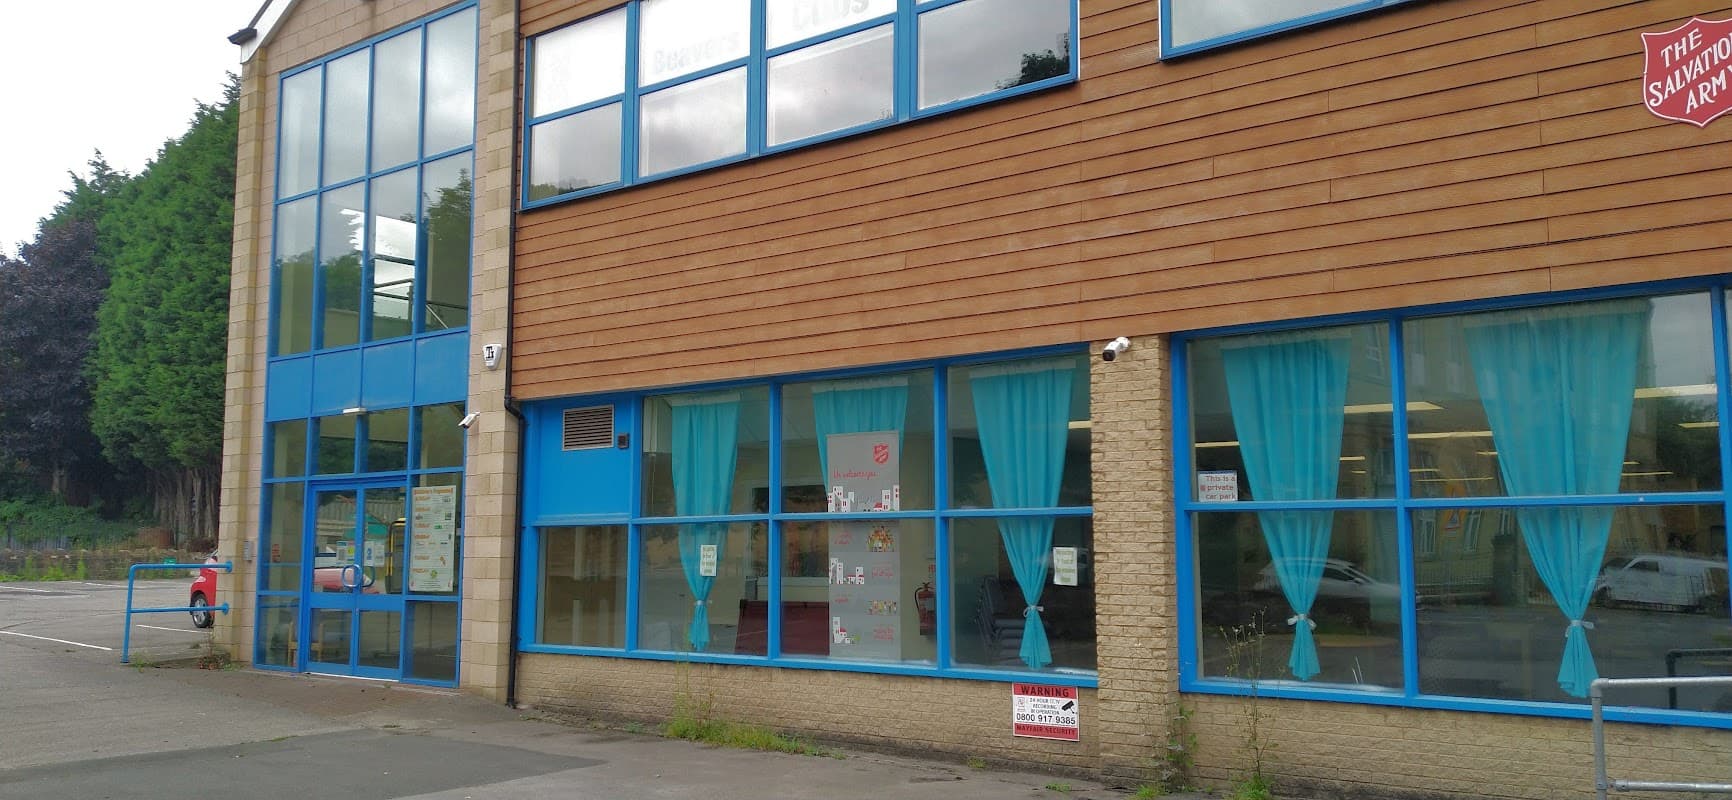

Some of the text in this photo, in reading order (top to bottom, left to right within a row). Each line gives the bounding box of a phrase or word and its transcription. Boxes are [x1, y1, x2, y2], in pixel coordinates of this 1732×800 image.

[654, 32, 741, 74] Beavers
[1661, 28, 1702, 68] THE
[1649, 32, 1732, 107] SALVATIO
[1021, 686, 1069, 697] WARNING
[1016, 712, 1076, 725] 0800 917 9385
[1016, 724, 1075, 736] MAYFAIR SECURITY
